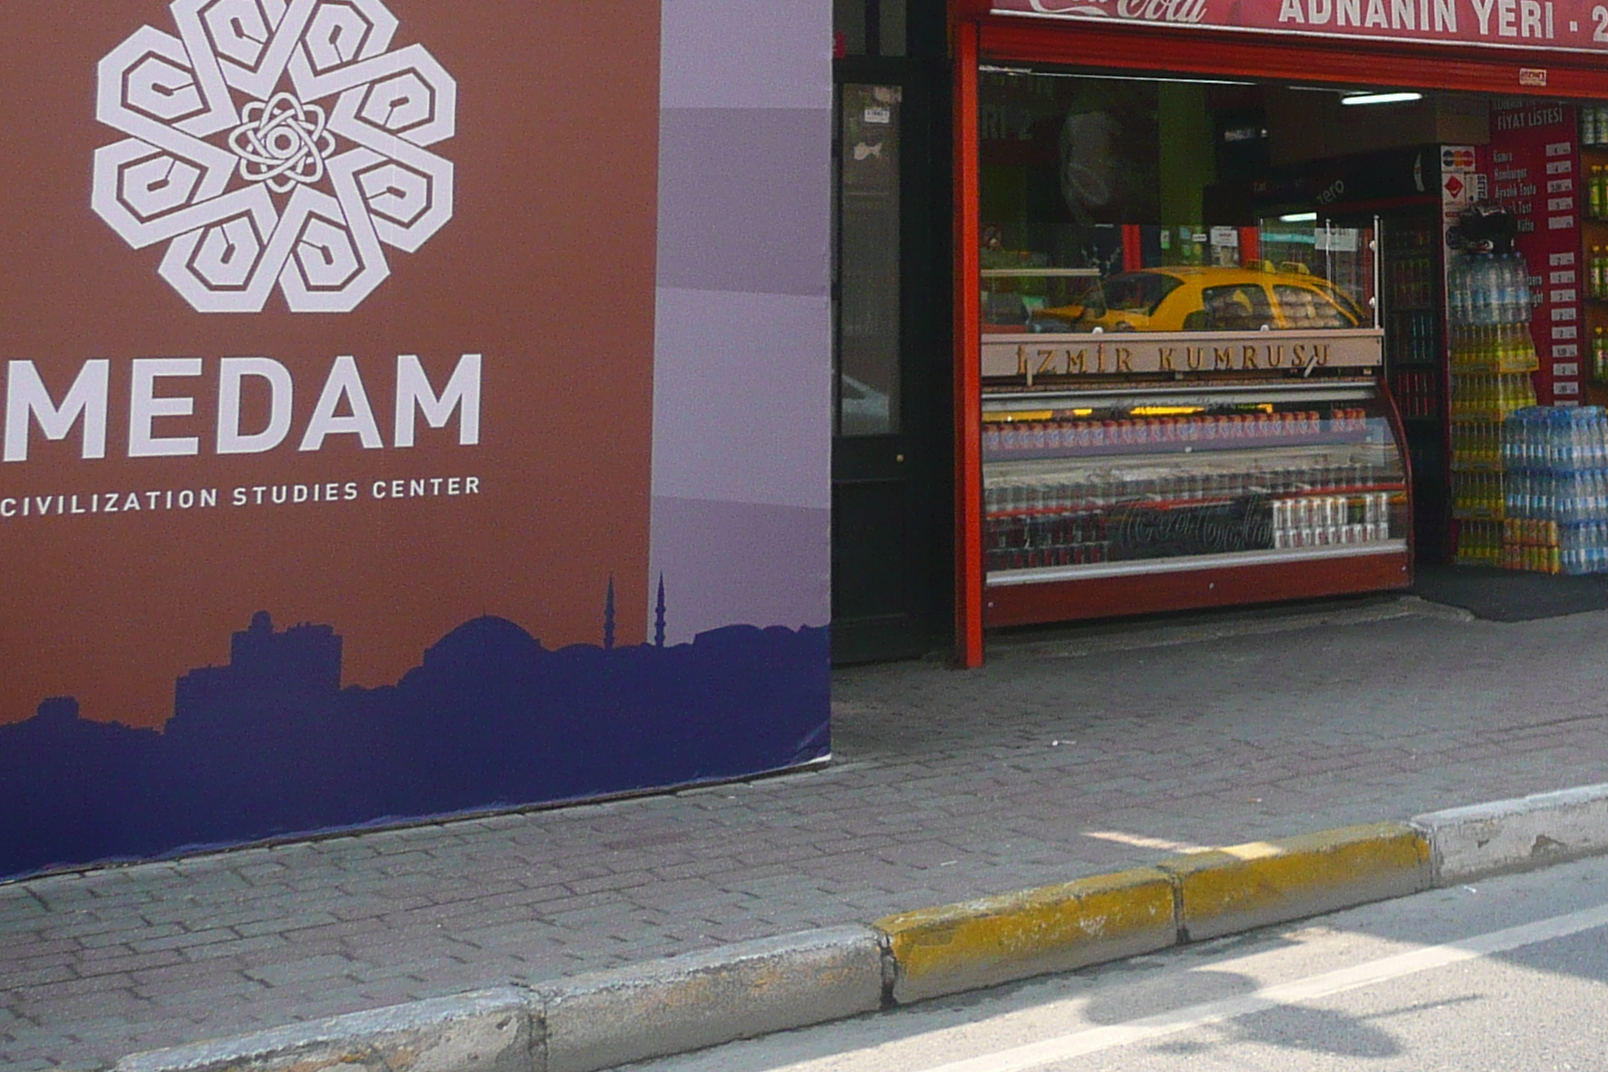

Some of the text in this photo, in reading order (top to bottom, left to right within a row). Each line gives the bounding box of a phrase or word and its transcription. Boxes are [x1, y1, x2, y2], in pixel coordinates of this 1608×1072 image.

[1496, 104, 1563, 130] FİYAT LİSTESİ
[1017, 343, 1331, 375] İZMİR KUMRUSU
[3, 354, 482, 462] MEDAM
[1, 476, 480, 517] CIVILIZATION STUDIES CENTER
